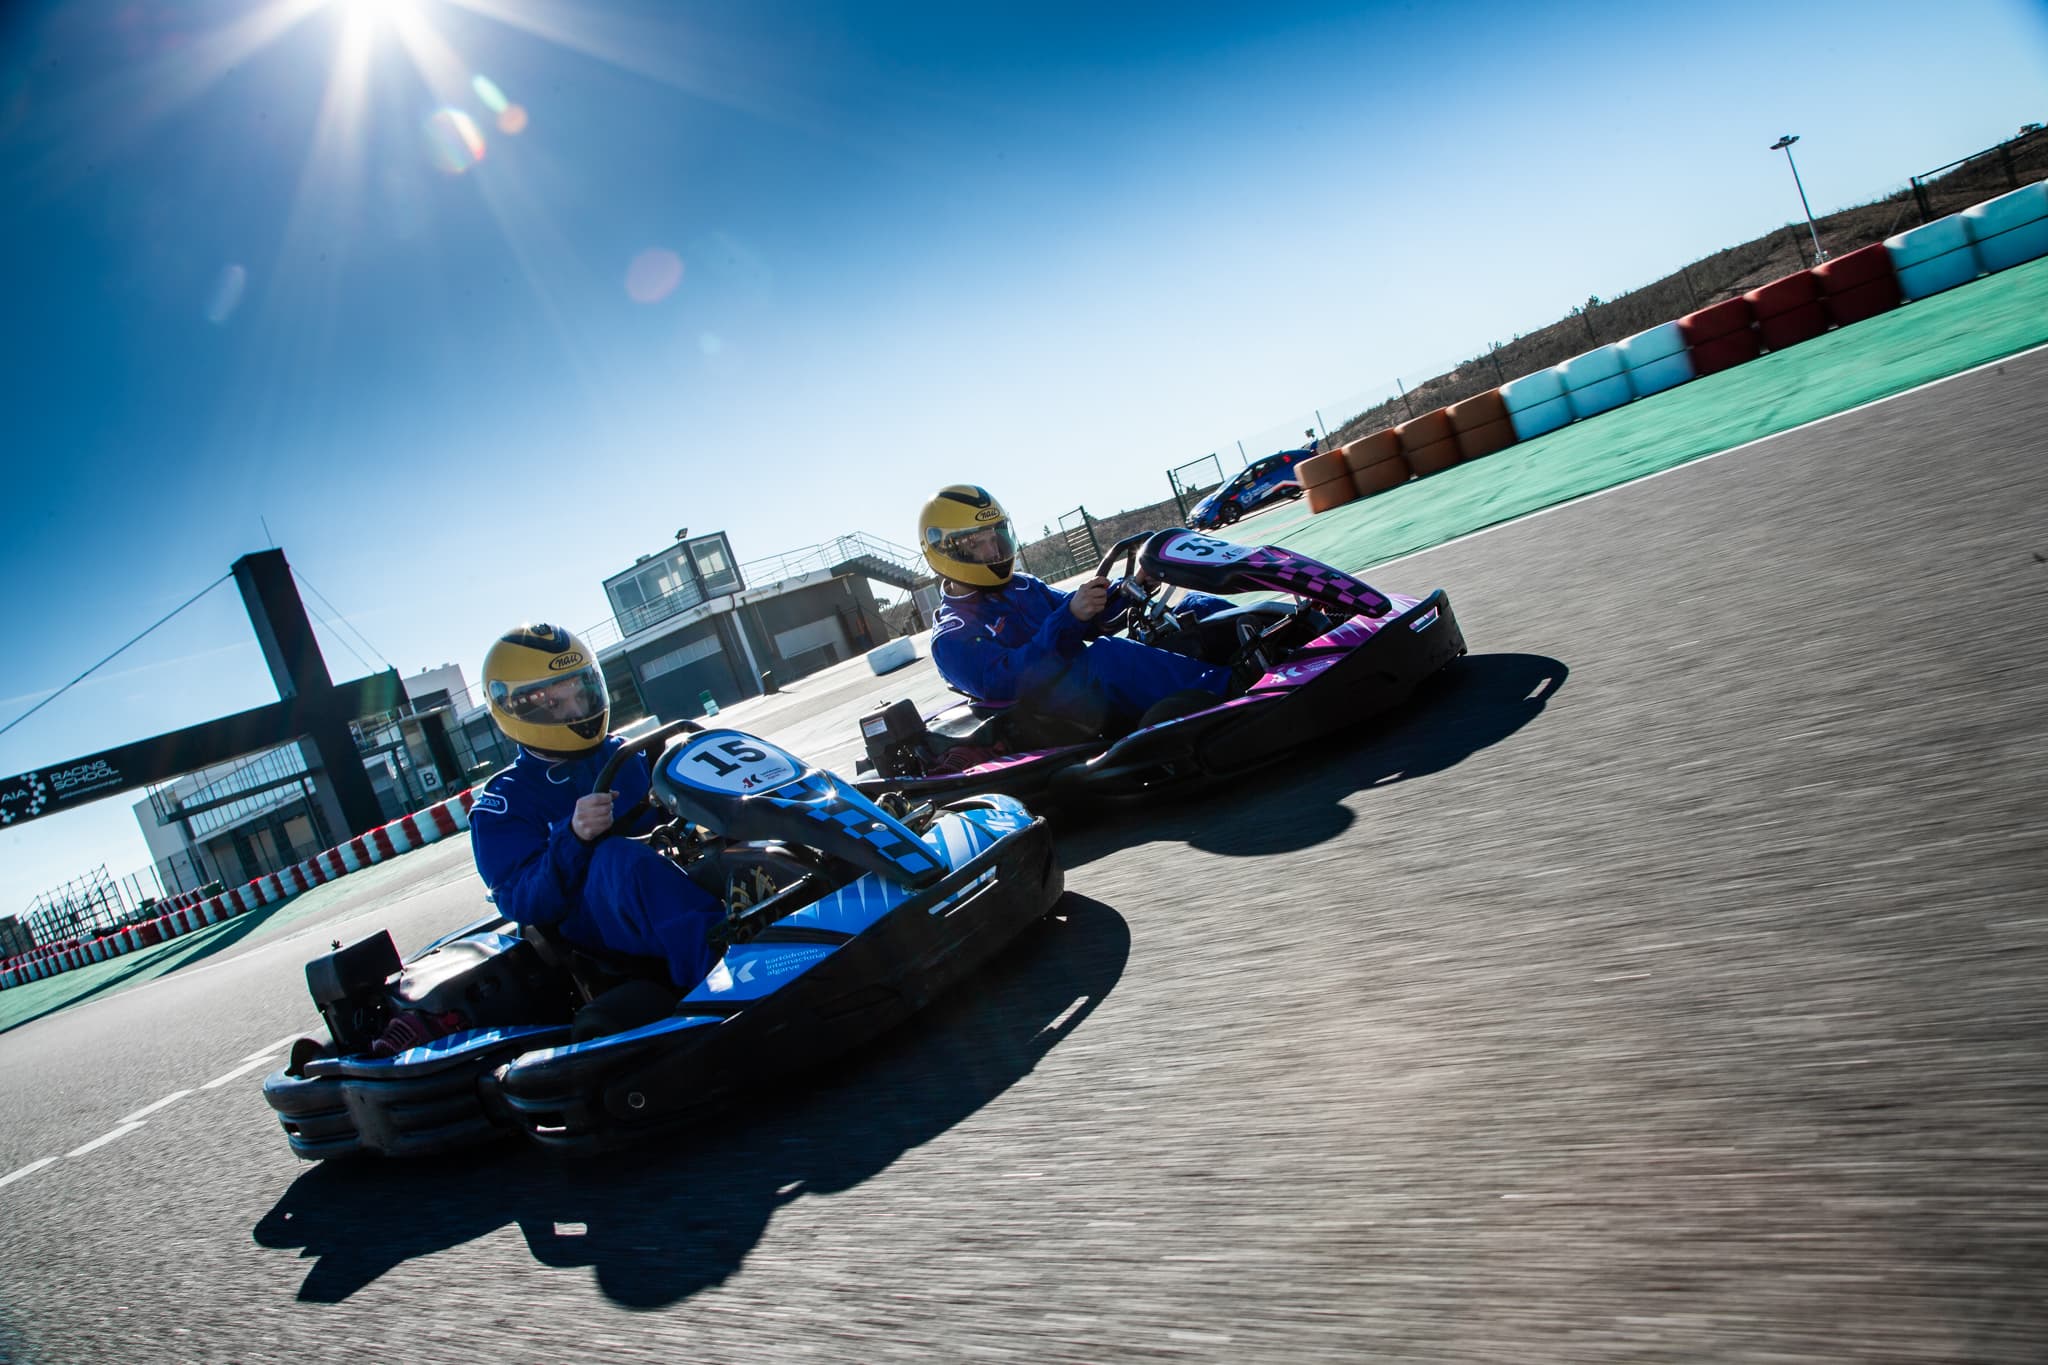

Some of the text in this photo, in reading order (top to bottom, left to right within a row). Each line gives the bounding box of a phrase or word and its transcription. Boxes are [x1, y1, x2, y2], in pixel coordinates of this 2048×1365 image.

[693, 740, 767, 777] 15
[50, 759, 107, 782] RACING
[54, 767, 119, 791] SCHOOL
[423, 772, 437, 786] B
[767, 964, 800, 977] algarve
